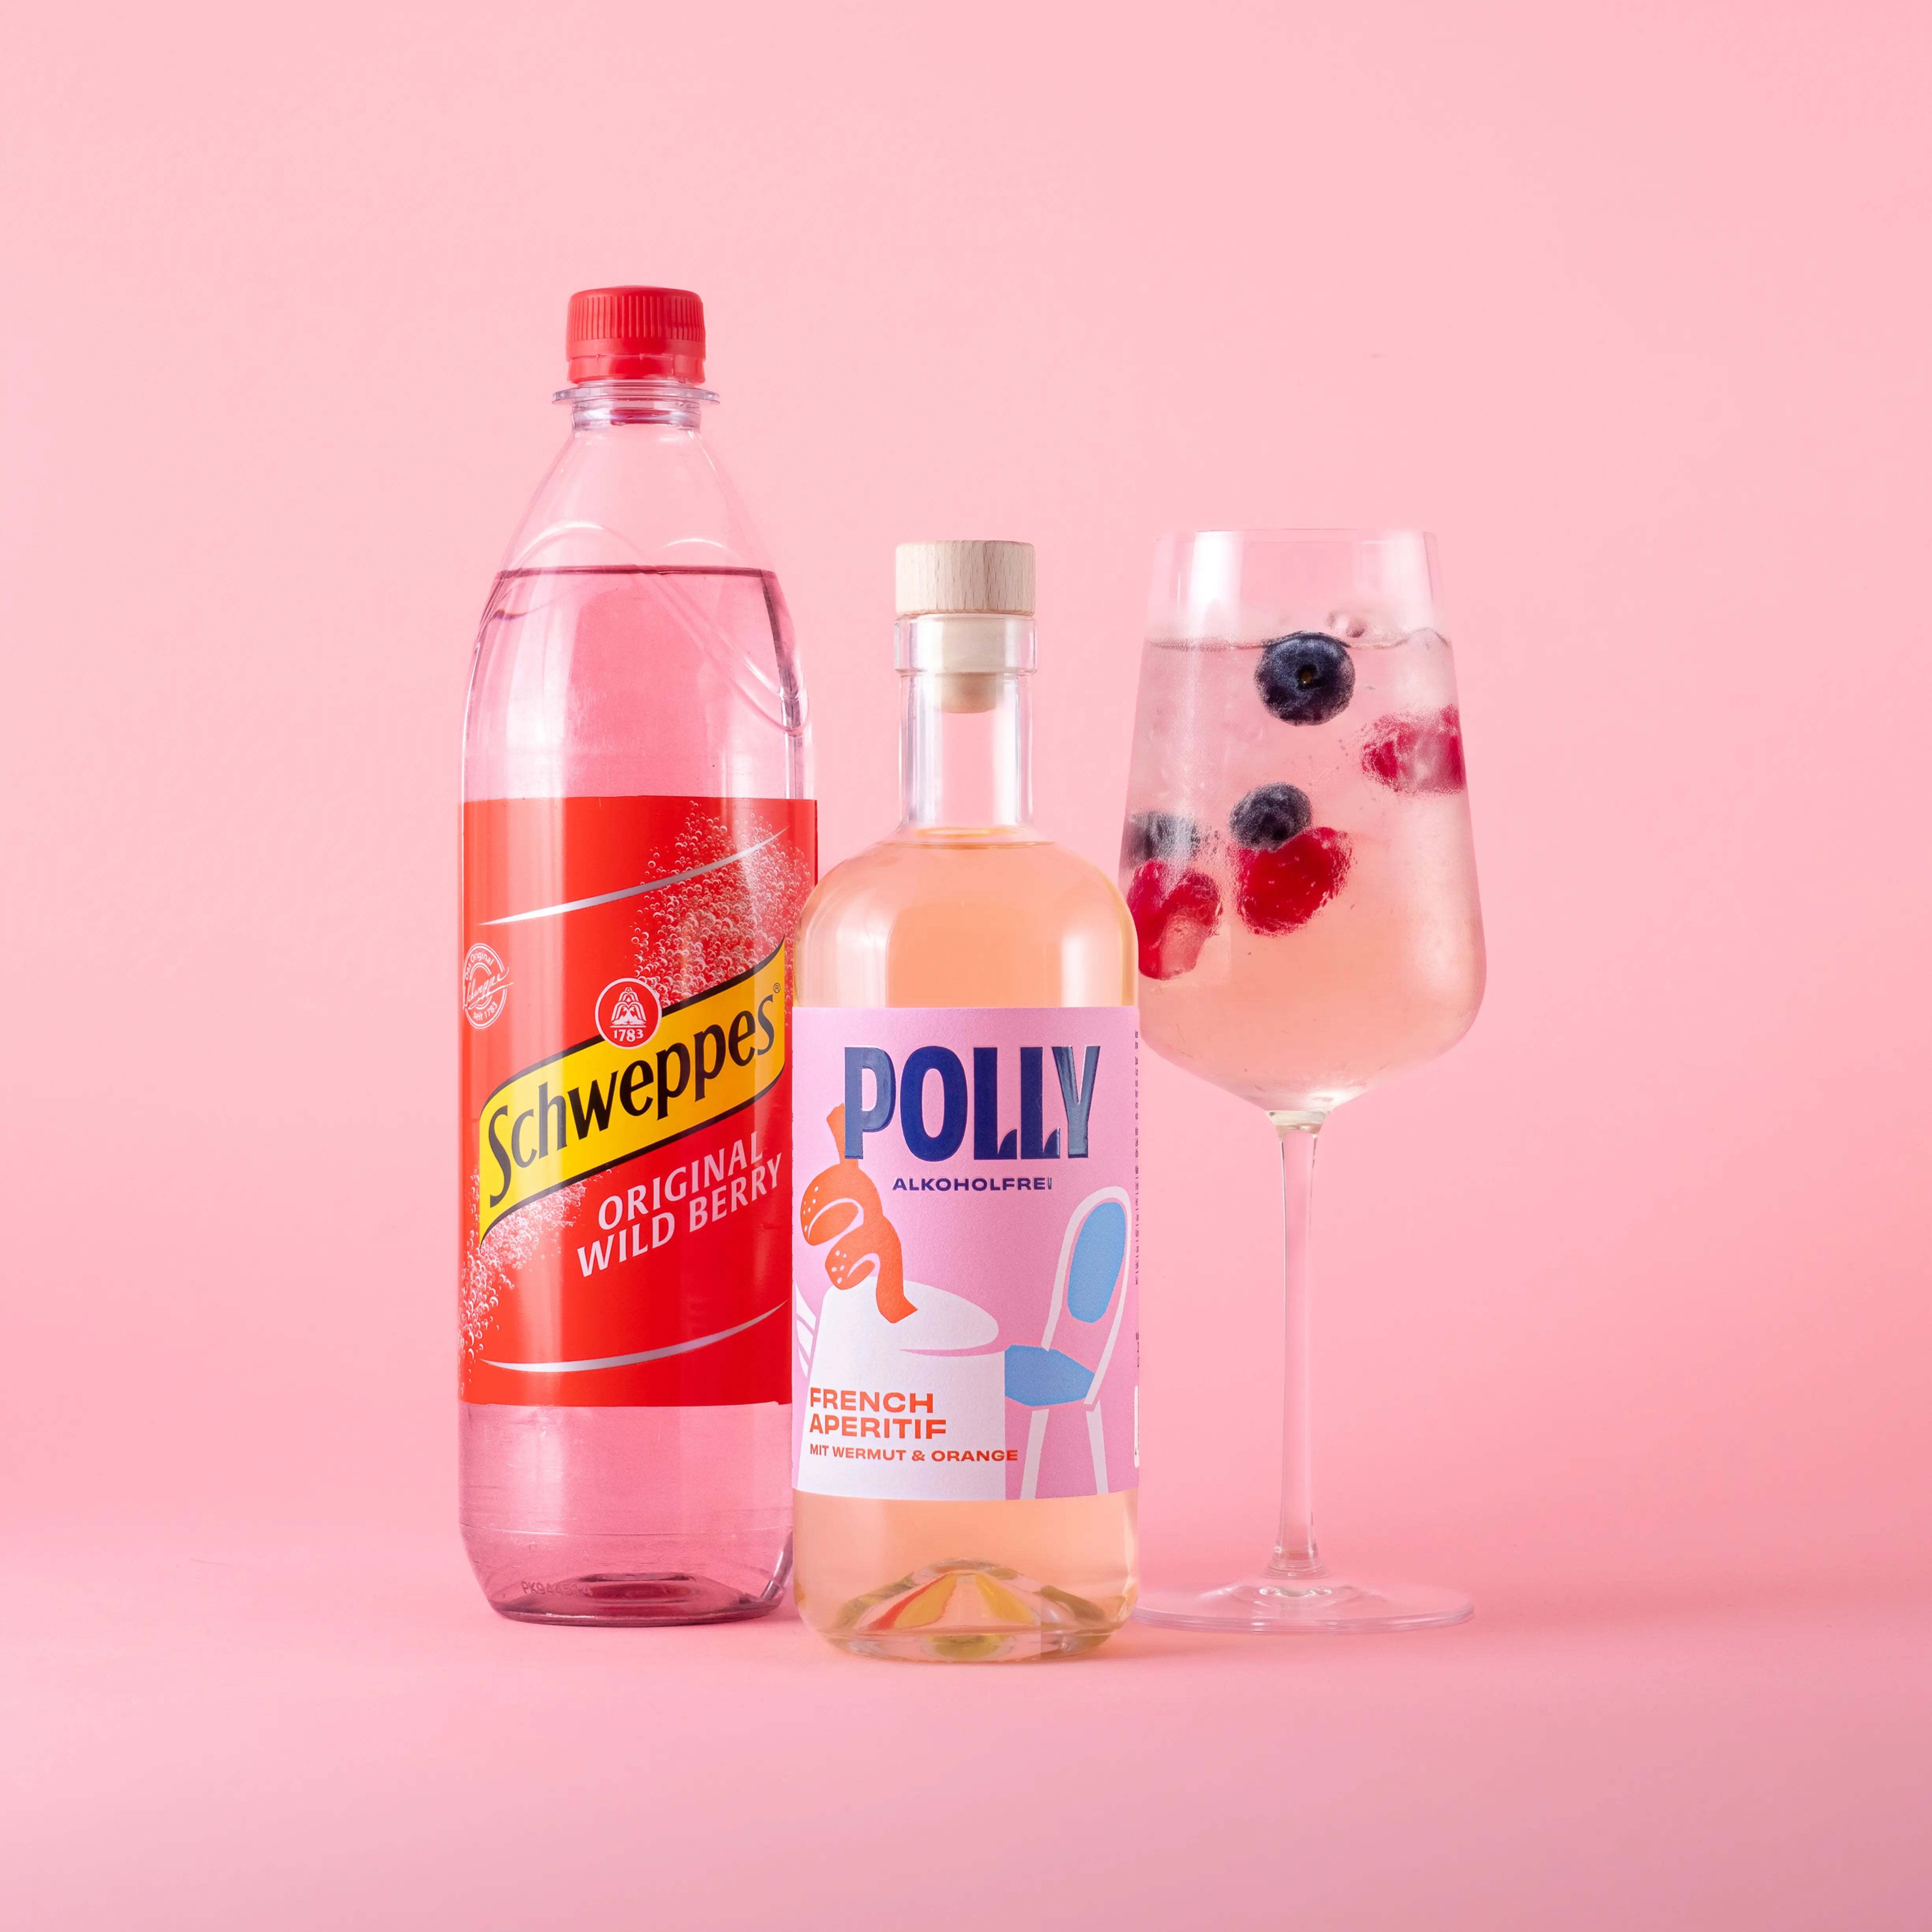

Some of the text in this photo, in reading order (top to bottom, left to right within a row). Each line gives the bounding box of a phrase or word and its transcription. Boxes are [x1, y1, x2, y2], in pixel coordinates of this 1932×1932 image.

[470, 951, 494, 966] Original
[474, 1001, 498, 1021] seit 1783
[614, 1029, 644, 1042] 1783
[488, 994, 775, 1207] Schweppes
[844, 1045, 1101, 1162] POLLY
[599, 1131, 763, 1230] ORIGINAL
[892, 1177, 1052, 1192] ALKOHOLFREI
[577, 1152, 782, 1277] WILD BERRY
[810, 1387, 933, 1414] FRENCH
[809, 1413, 946, 1440] APERITIF
[810, 1443, 1018, 1462] MIT WERMUT & ORANGE
